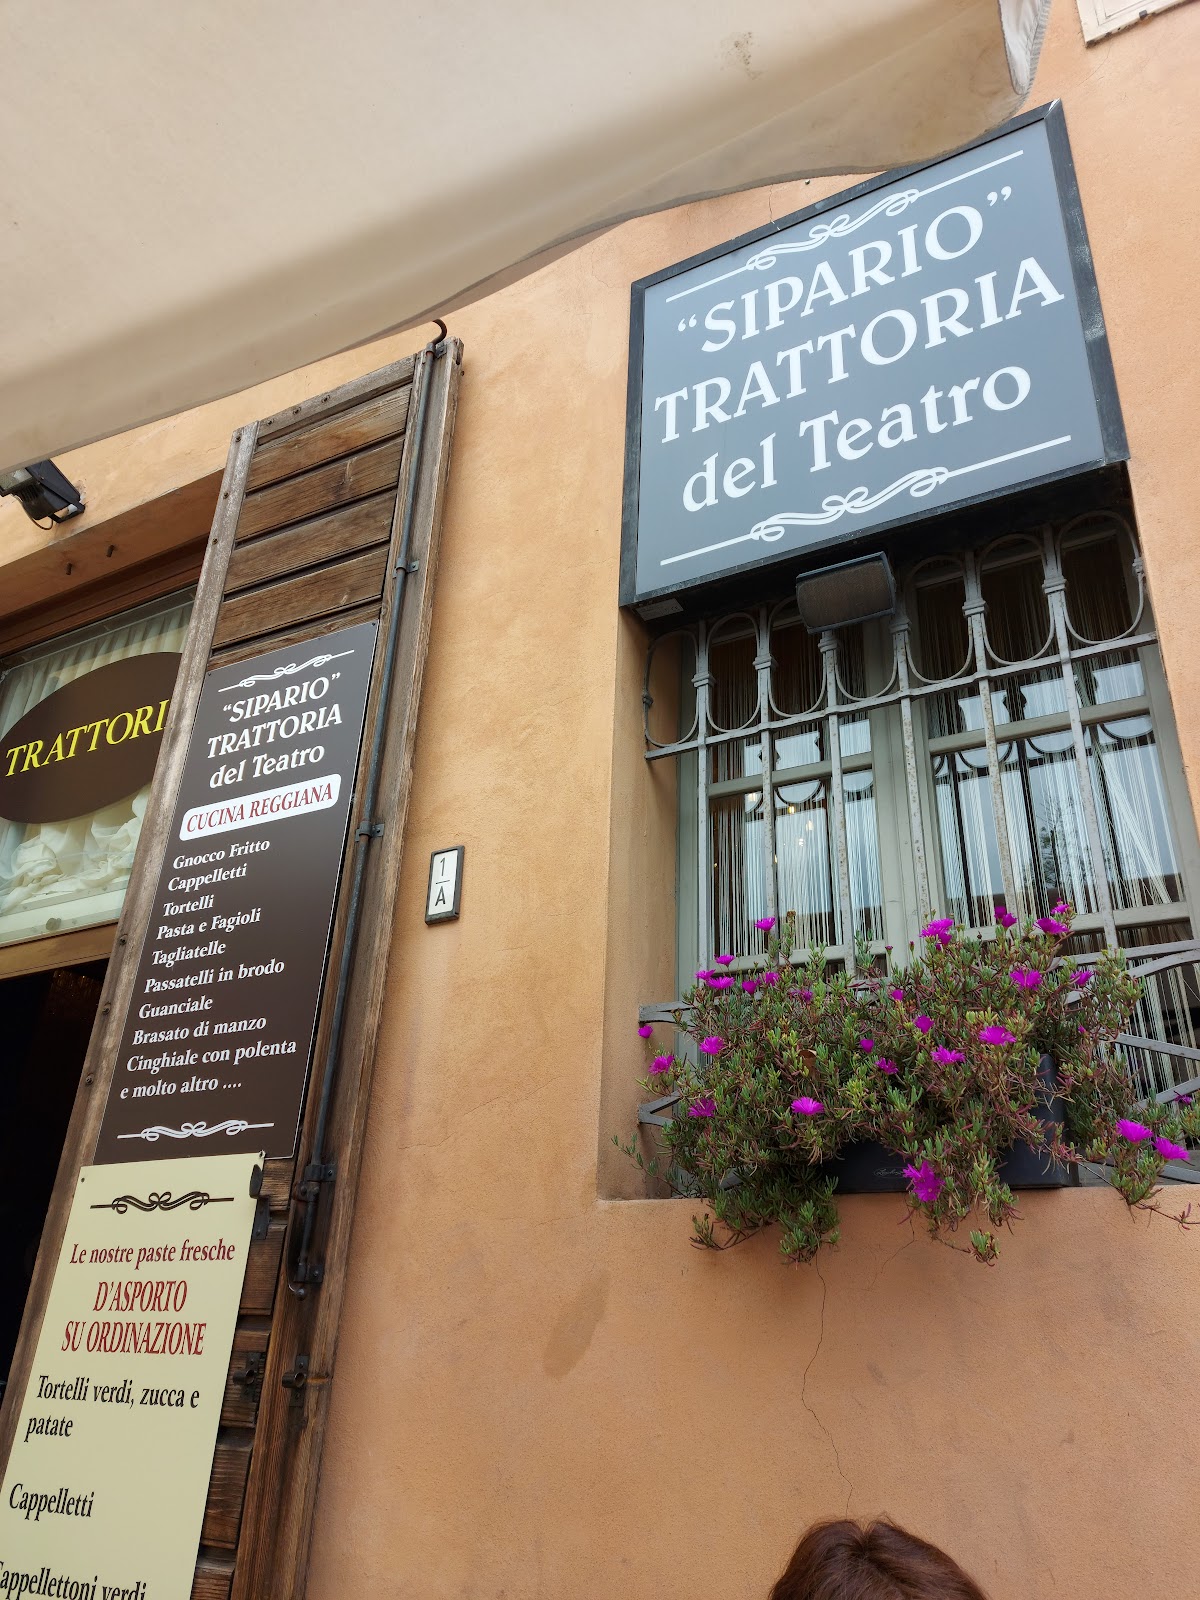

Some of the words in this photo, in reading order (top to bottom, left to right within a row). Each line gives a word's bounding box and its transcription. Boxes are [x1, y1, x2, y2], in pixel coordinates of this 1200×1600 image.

[677, 186, 1012, 352] “SIPARIO”
[654, 256, 1065, 444] TRATTORIA
[682, 433, 778, 512] del
[800, 365, 1031, 473] Teatro
[207, 703, 343, 759] TRATTORIA
[209, 759, 247, 788] del
[252, 745, 325, 778] Teatro
[186, 803, 245, 833] CUCINA
[248, 782, 333, 819] REGGIANA
[173, 848, 226, 870] Gnocco
[229, 838, 271, 860] Fritto
[440, 857, 446, 877] 1
[168, 863, 248, 893] Cappelletti
[163, 895, 215, 917] Tortelli
[435, 886, 446, 907] A
[156, 921, 195, 940] Pasta
[198, 919, 207, 933] e
[210, 908, 262, 933] Fagioli
[151, 940, 227, 968] Tagliatelle
[144, 968, 214, 994] Passatelli
[217, 964, 234, 983] in
[238, 958, 285, 980] brodo
[138, 996, 213, 1019] Guanciale
[132, 1025, 190, 1046] Brasato
[193, 1020, 210, 1038] di
[212, 1016, 267, 1035] manzo
[126, 1048, 199, 1075] Cinghiale
[202, 1048, 230, 1064] con
[233, 1039, 297, 1065] polenta
[120, 1085, 129, 1100] e
[132, 1077, 177, 1099] molto
[180, 1074, 219, 1095] altro
[70, 1243, 86, 1264] Le
[89, 1245, 134, 1264] nostre
[134, 1244, 177, 1271] paste
[179, 1238, 236, 1262] fresche
[61, 1320, 87, 1352] SU
[86, 1321, 207, 1356] ORDINAZIONE
[37, 1375, 90, 1402] Tortelli
[93, 1379, 134, 1409] verdi,
[139, 1388, 185, 1408] zucca
[190, 1389, 200, 1408] e
[24, 1415, 74, 1443] patate
[9, 1483, 95, 1522] Cappelletti
[0, 1560, 98, 1600] appellettoni
[102, 1580, 147, 1600] verdi
